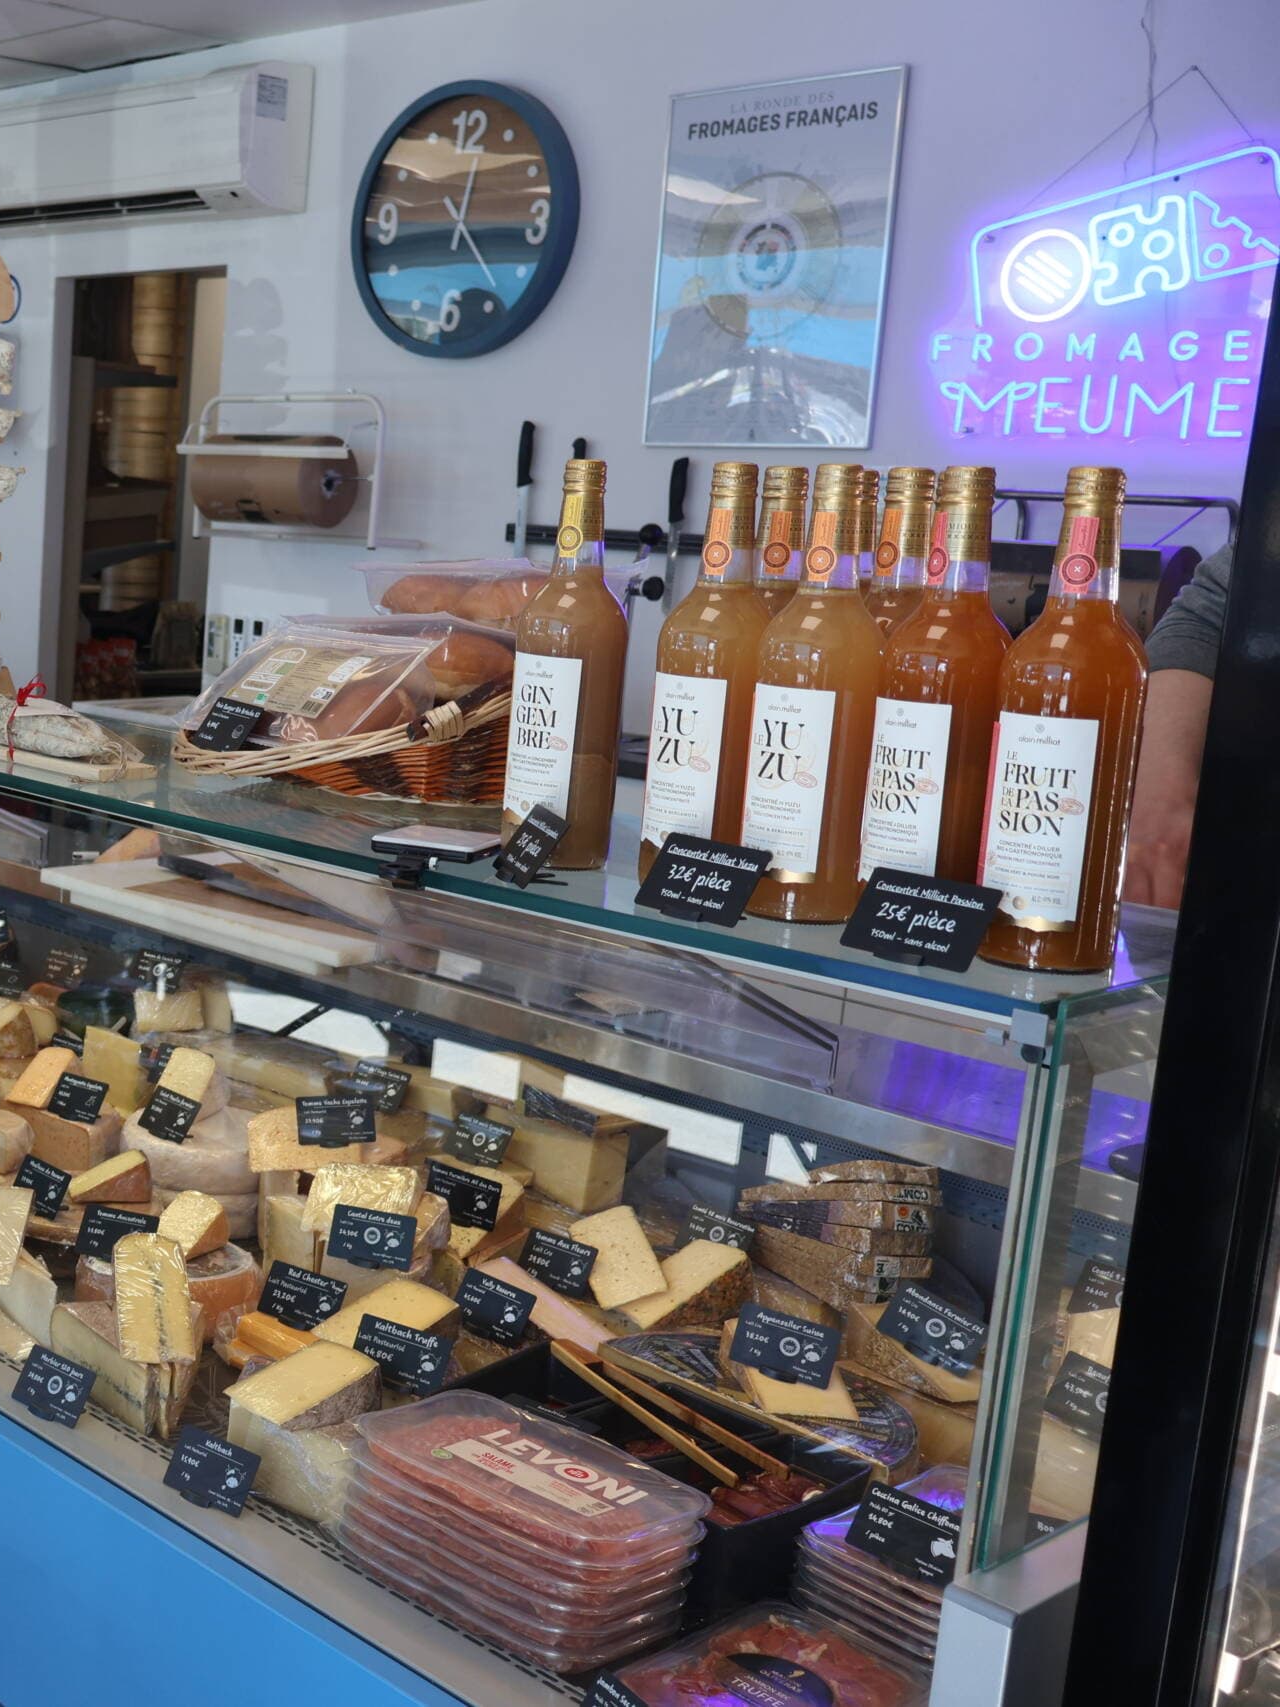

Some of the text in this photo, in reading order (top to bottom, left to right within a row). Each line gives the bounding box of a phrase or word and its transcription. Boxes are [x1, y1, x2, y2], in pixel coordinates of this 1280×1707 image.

[730, 91, 834, 114] LA RONDE DES
[452, 109, 487, 155] 12
[688, 101, 878, 140] FROMAGES FRANÇAIS
[378, 202, 399, 246] 9
[525, 199, 550, 245] 3
[440, 289, 462, 332] 6
[931, 330, 1252, 363] FROMAGE
[521, 684, 554, 706] GIN
[516, 708, 557, 729] GEM
[662, 706, 699, 737] YU
[517, 727, 551, 750] BRE
[763, 719, 805, 750] YU
[657, 736, 696, 767] ZU
[875, 744, 931, 770] FRUIT
[1006, 750, 1018, 761] LE
[758, 750, 802, 782] ZU
[1004, 762, 1076, 789] FRUIT
[882, 768, 916, 792] PAS
[870, 790, 920, 815] SION
[1003, 786, 1060, 813] DE PAS
[999, 811, 1064, 837] SION
[667, 843, 759, 872] Concentré Milliat Yuzu
[668, 864, 732, 892] 32€ pièce
[703, 898, 724, 910] alcool
[876, 880, 984, 910] Concentré Milliat Passion
[876, 902, 956, 933] 25€ pièce
[904, 937, 923, 947] sans
[925, 940, 950, 952] alcool
[348, 1210, 368, 1219] Cantal
[386, 1216, 401, 1225] deux
[557, 1240, 570, 1249] Aux
[571, 1244, 590, 1256] Fleurs
[288, 1268, 329, 1287] Red Chester
[1091, 1266, 1115, 1280] Comté
[944, 1308, 972, 1326] Fermier
[358, 1331, 406, 1352] Lait Pasteurisé
[375, 1321, 438, 1348] Kaltbach Truffe
[803, 1326, 824, 1338] Suisse
[1087, 1366, 1111, 1384] Beauf
[205, 1440, 232, 1457] Kaltbach
[480, 1428, 649, 1506] LEVONI
[901, 1500, 926, 1517] Galice
[927, 1511, 960, 1532] Chiffona
[597, 1676, 620, 1699] Jambon
